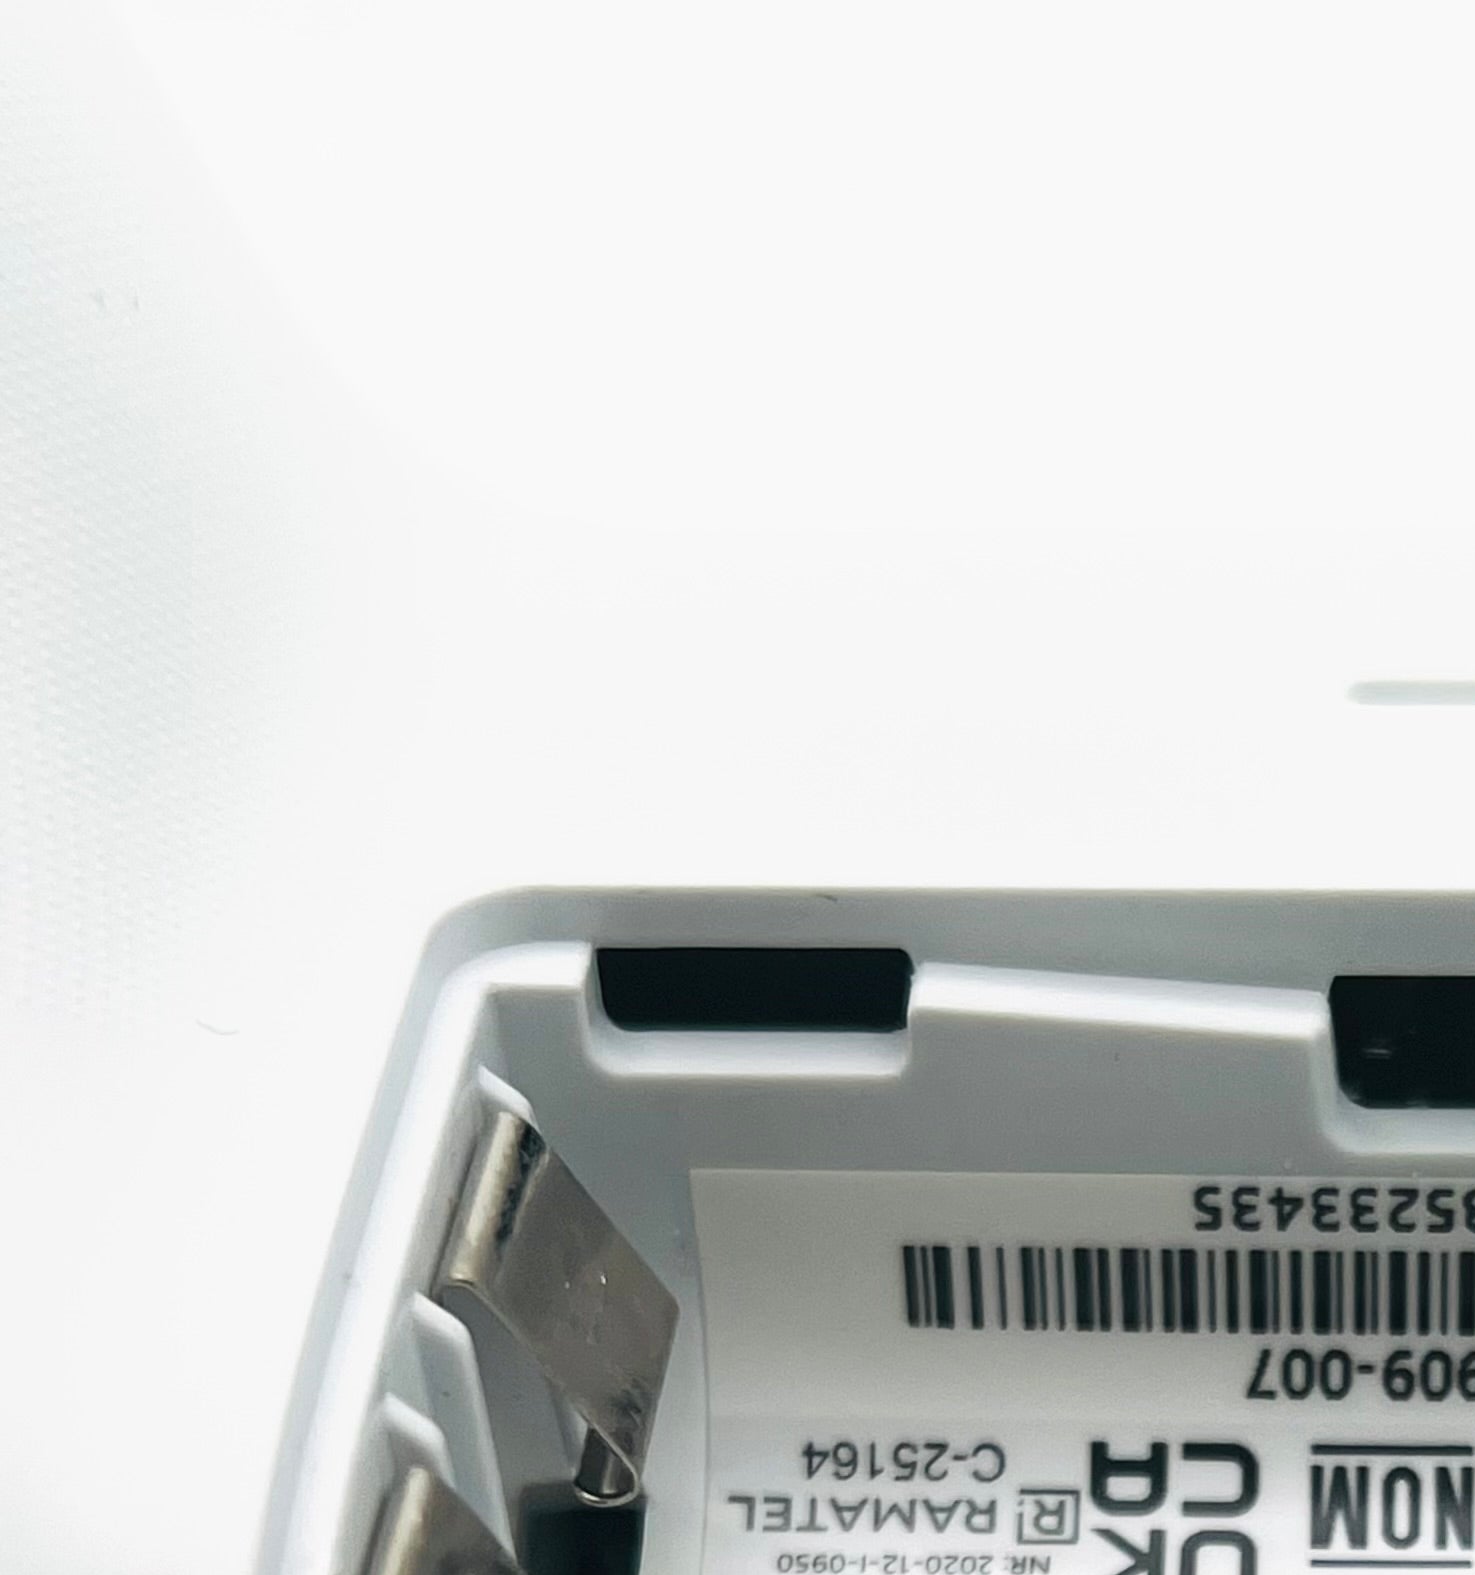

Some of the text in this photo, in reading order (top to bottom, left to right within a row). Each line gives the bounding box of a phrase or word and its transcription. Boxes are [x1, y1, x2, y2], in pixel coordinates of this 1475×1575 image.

[800, 1438, 1007, 1484] C-25164
[1087, 1438, 1261, 1519] CA
[726, 1493, 998, 1535] RAMATEL
